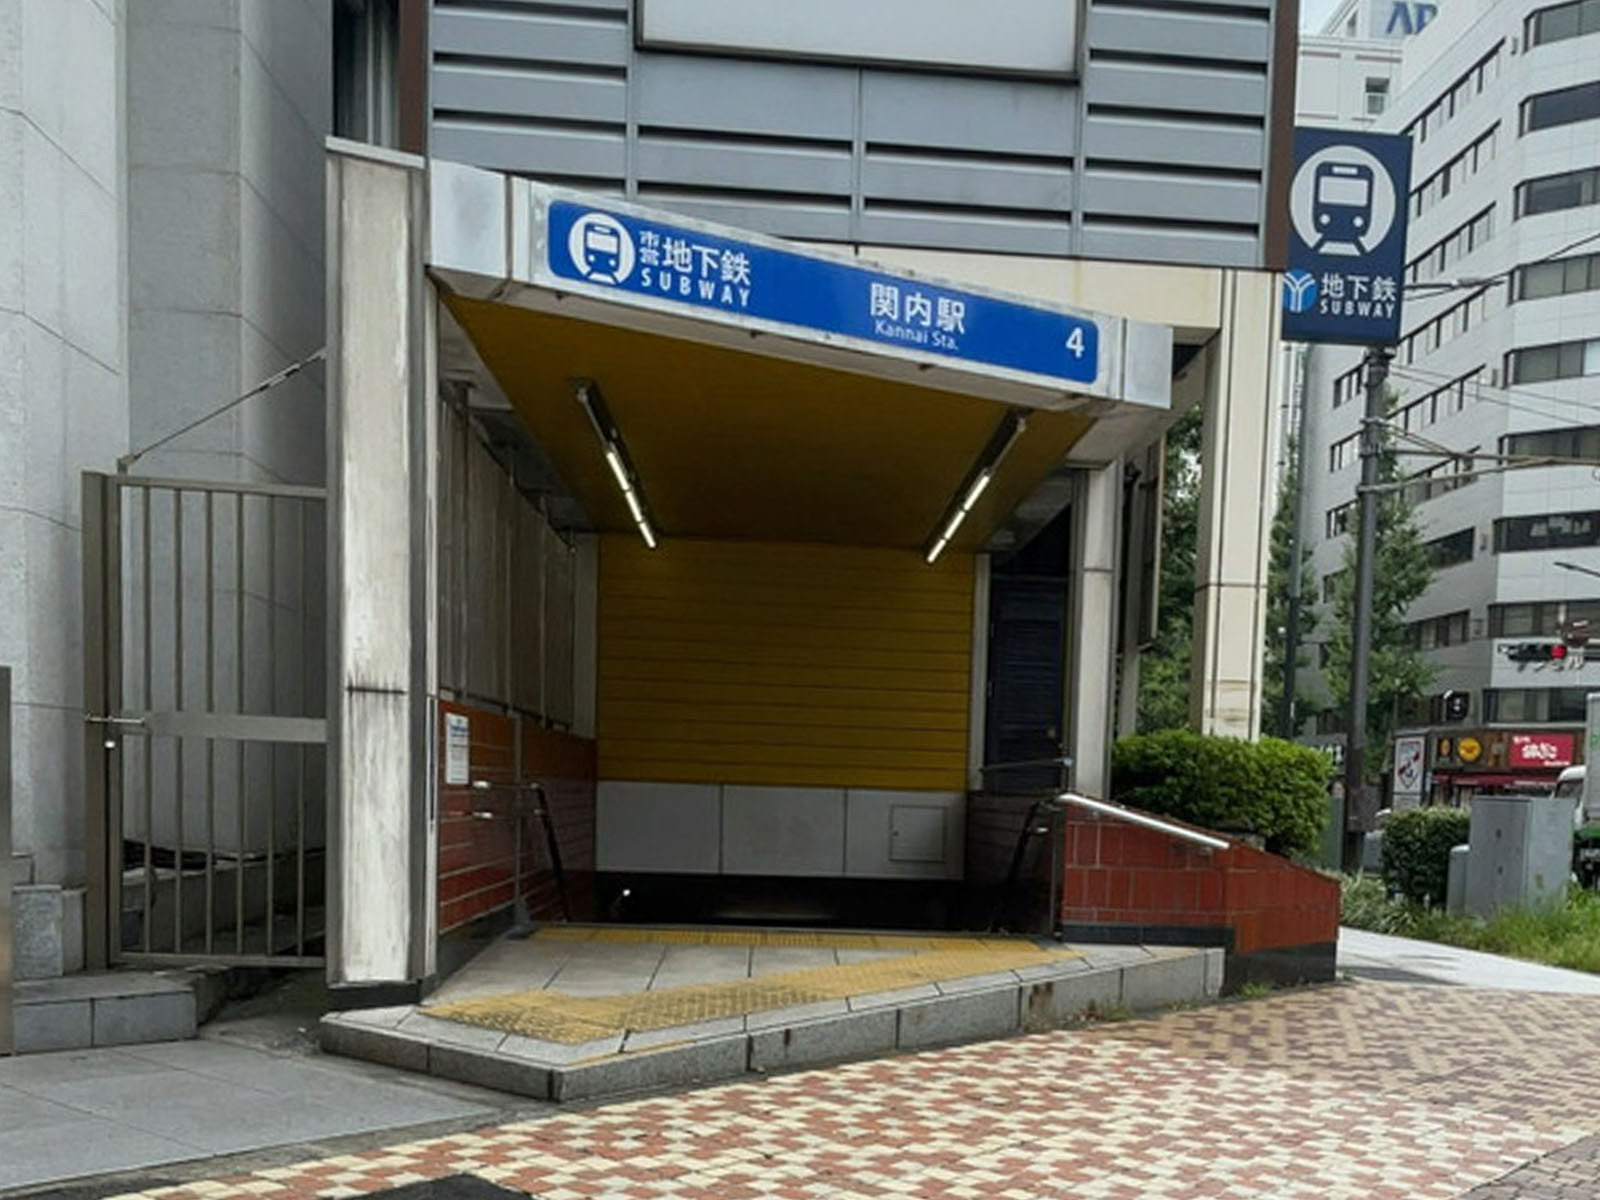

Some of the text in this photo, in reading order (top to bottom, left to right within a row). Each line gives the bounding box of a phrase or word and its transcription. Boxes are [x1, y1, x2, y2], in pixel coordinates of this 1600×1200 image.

[661, 236, 750, 286] 地下鉄
[640, 268, 750, 308] SUBWAY
[1320, 272, 1397, 302] 地下鉄
[870, 282, 966, 335] 関内駅
[1320, 299, 1395, 318] SUBWAY
[874, 319, 960, 351] Kannai Sta.
[1065, 326, 1085, 359] 4
